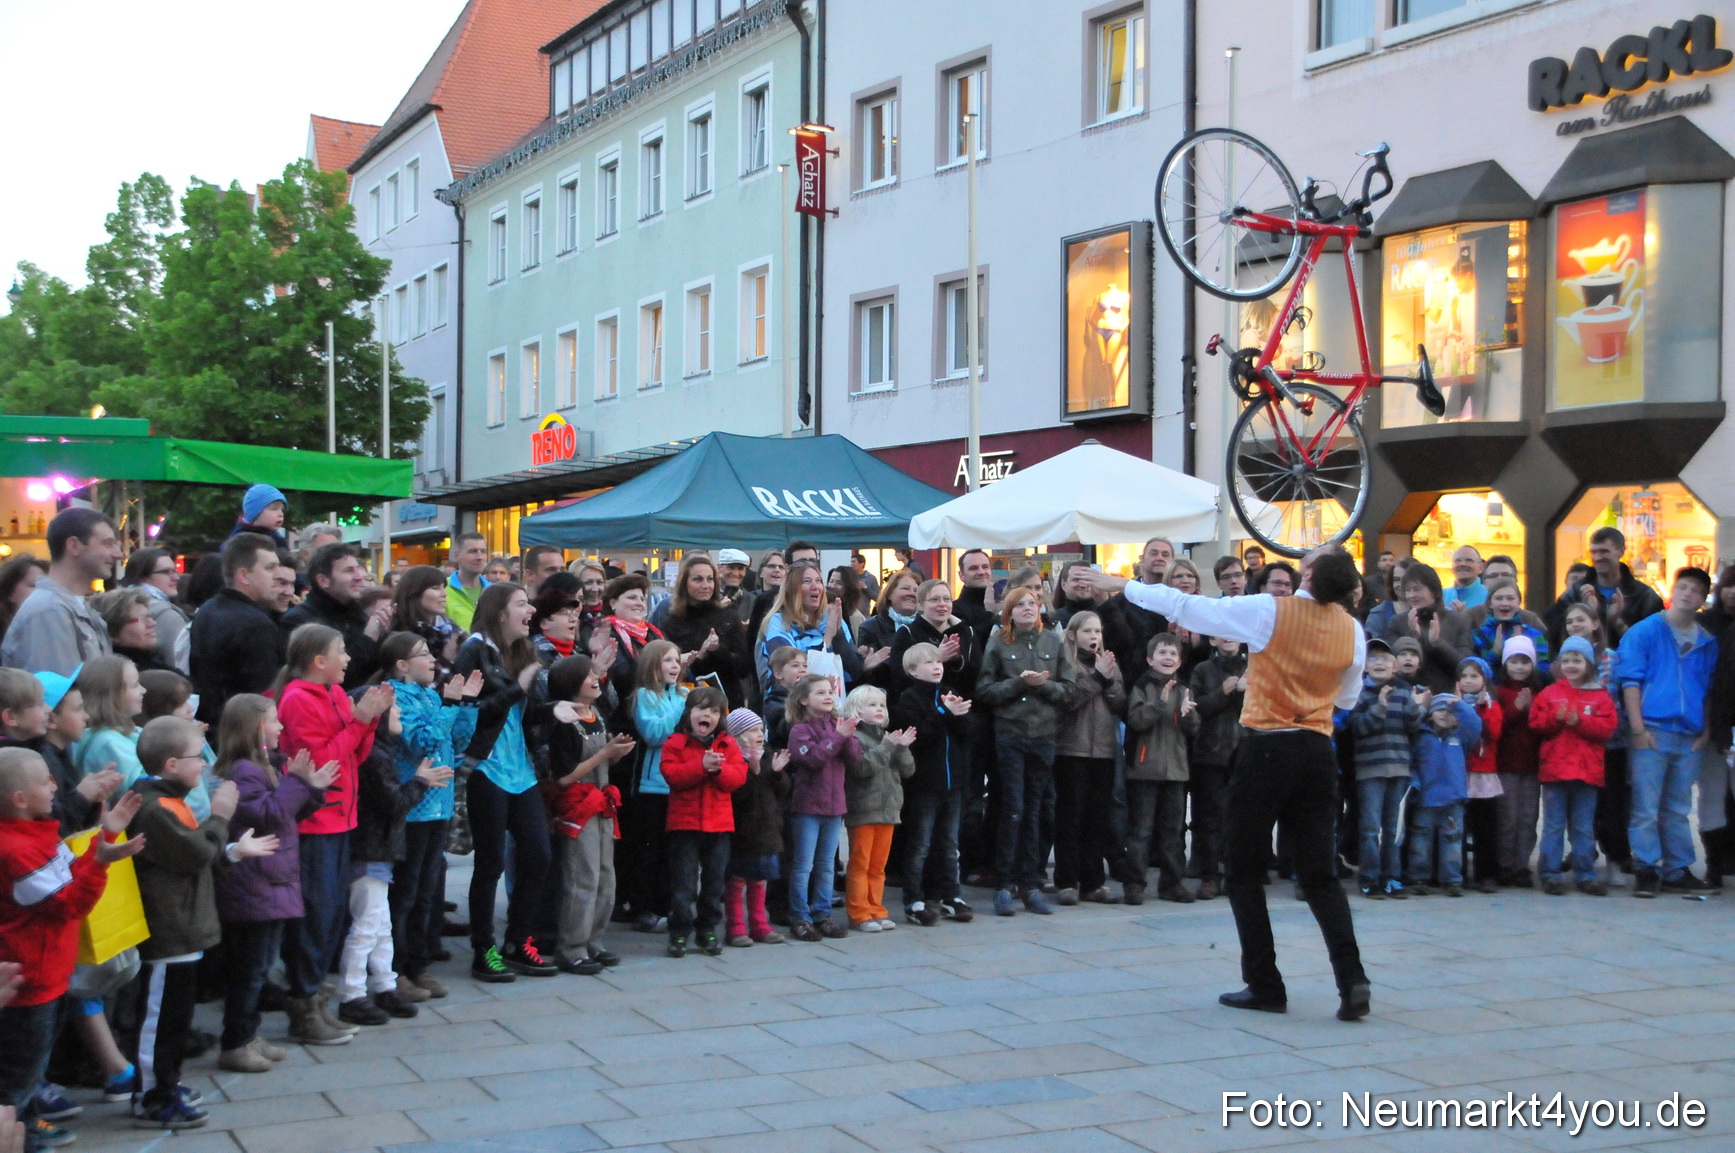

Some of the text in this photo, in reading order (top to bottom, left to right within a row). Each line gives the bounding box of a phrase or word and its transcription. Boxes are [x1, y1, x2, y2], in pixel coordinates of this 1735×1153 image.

[1528, 14, 1733, 112] RACKL
[1555, 83, 1712, 137] am Rathaus
[802, 143, 820, 208] Achatz
[531, 423, 577, 466] RENO
[953, 453, 1014, 487] Ahatz
[751, 486, 882, 517] RACKL
[1616, 514, 1656, 536] RACKL
